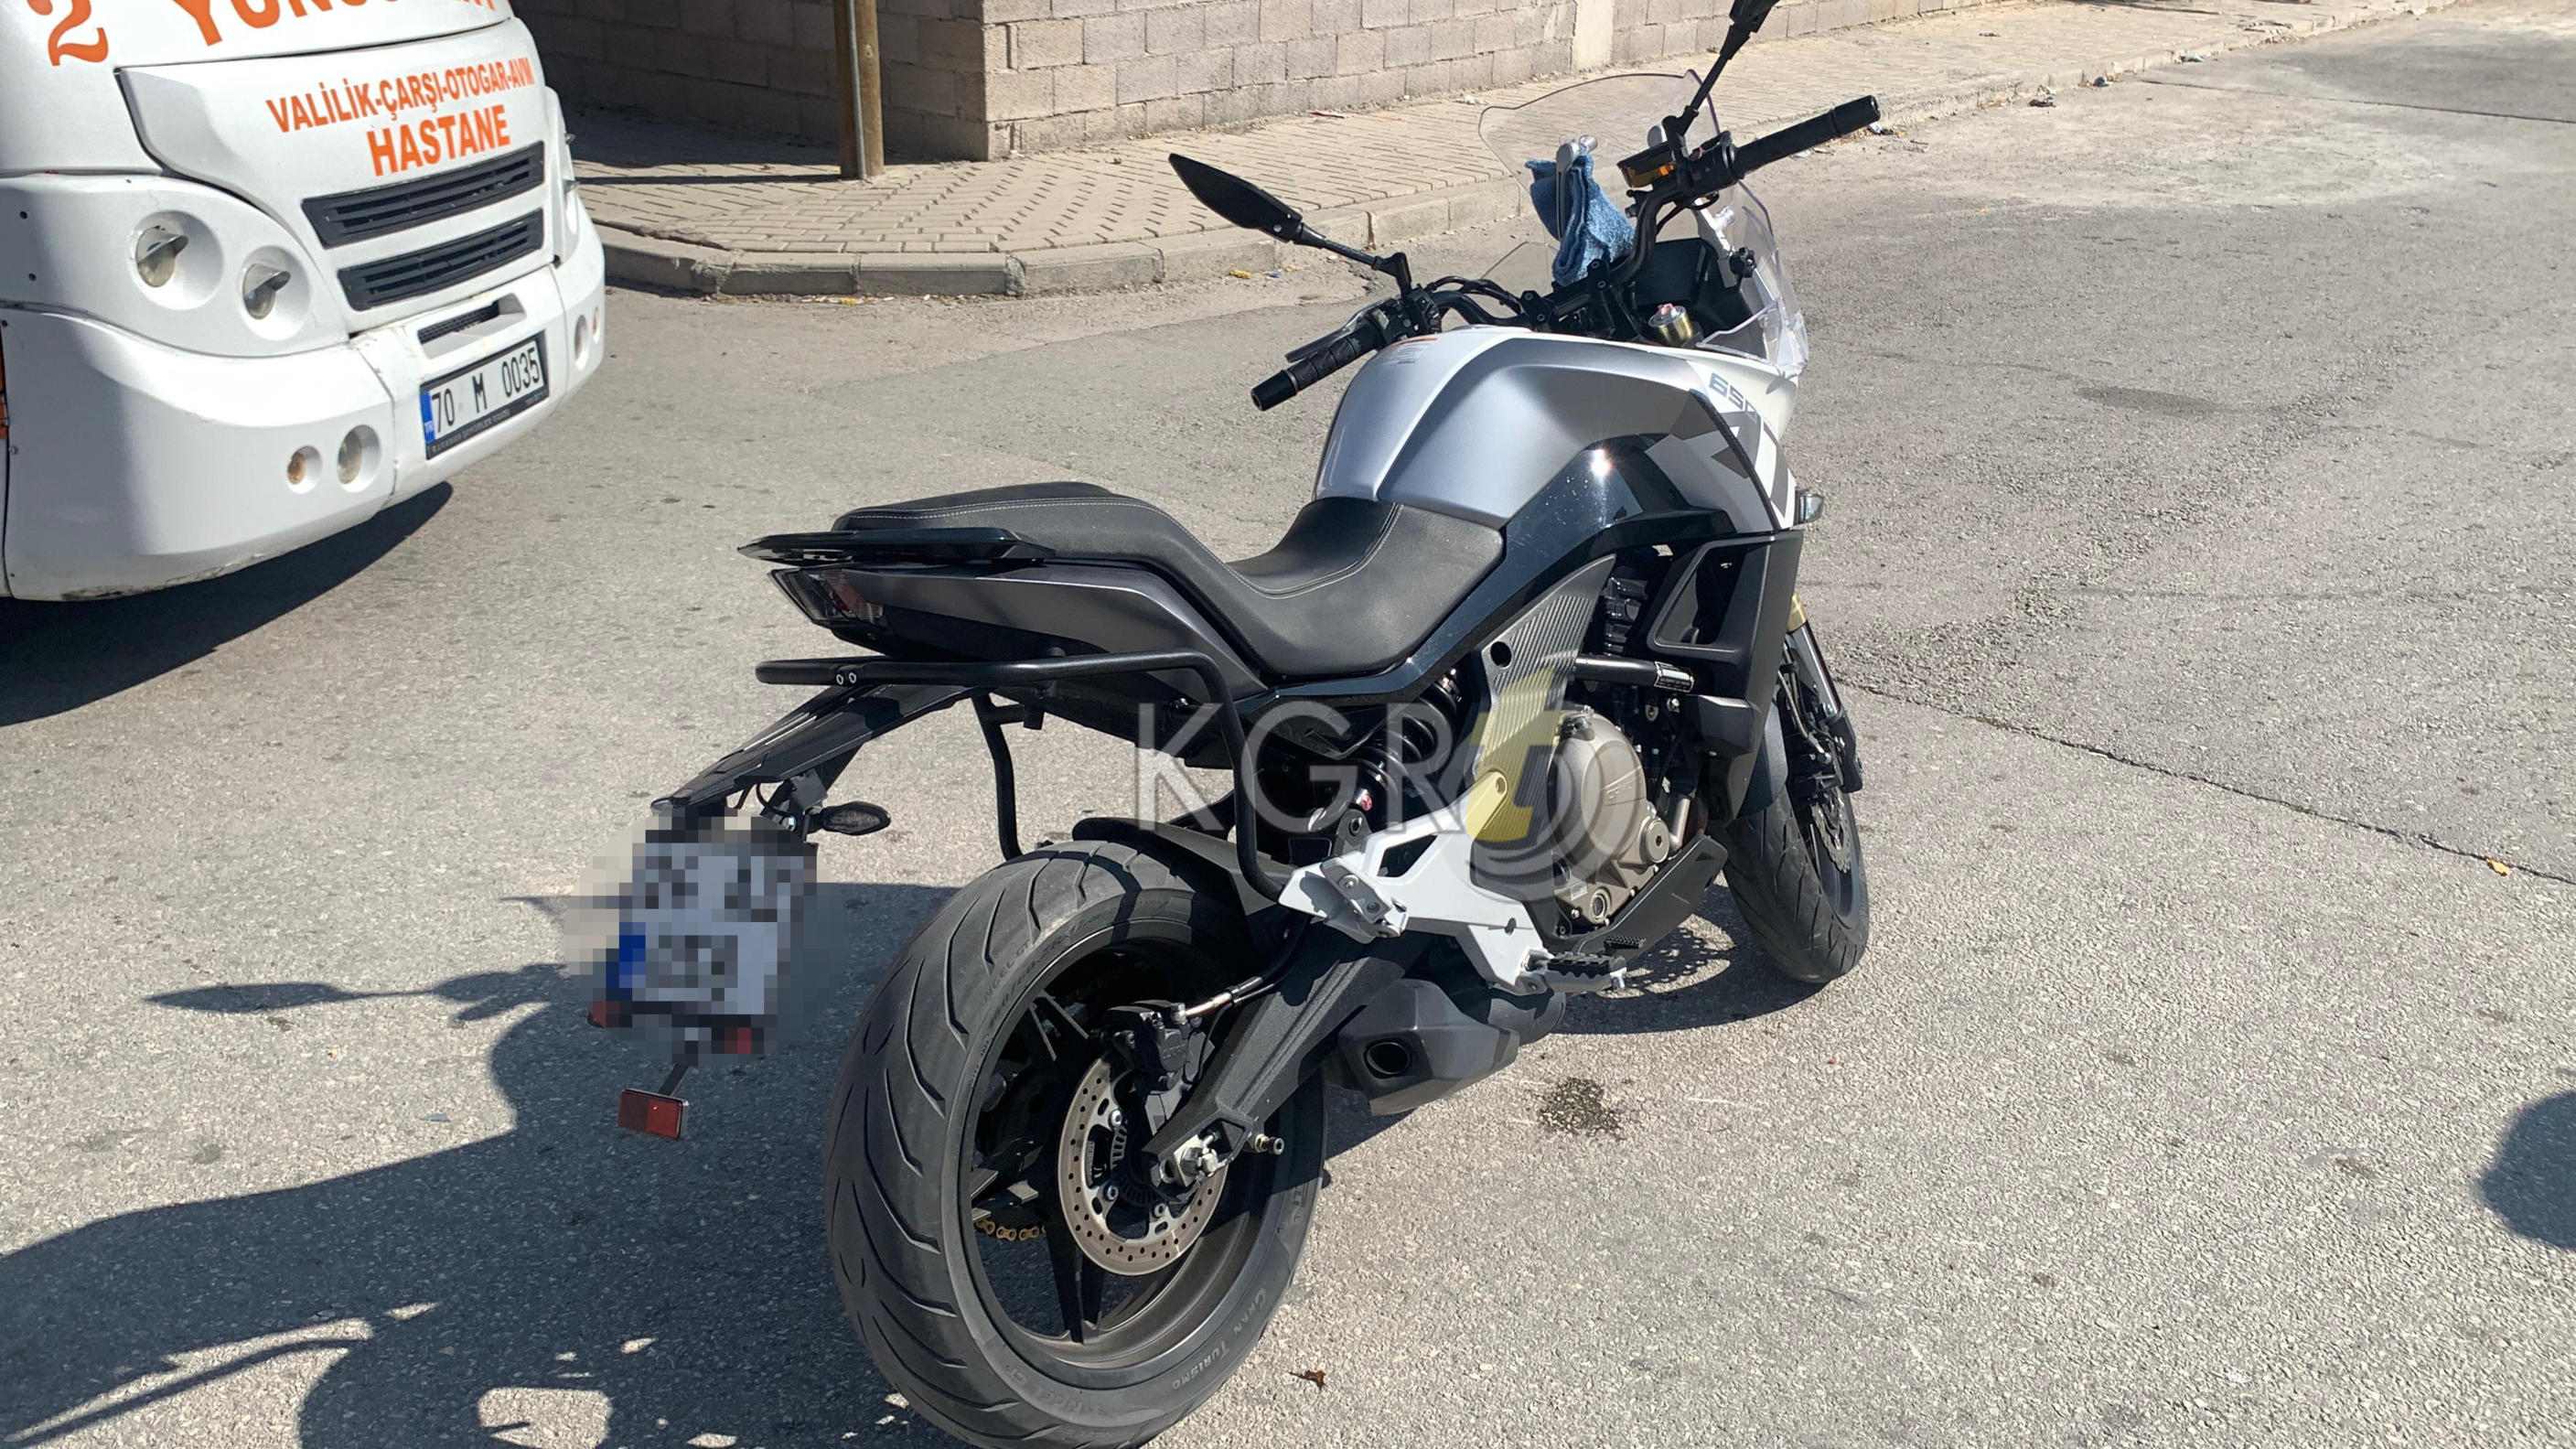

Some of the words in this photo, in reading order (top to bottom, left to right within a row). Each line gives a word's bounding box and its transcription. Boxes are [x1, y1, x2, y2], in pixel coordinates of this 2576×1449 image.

[265, 57, 535, 133] VALİLİK-ÇARŞI-OTOGAR-AVM
[366, 104, 510, 177] HASTANE
[431, 388, 456, 433] 70
[472, 372, 488, 413] M
[501, 347, 541, 399] 0035
[1172, 1340, 1230, 1390] TURISMO
